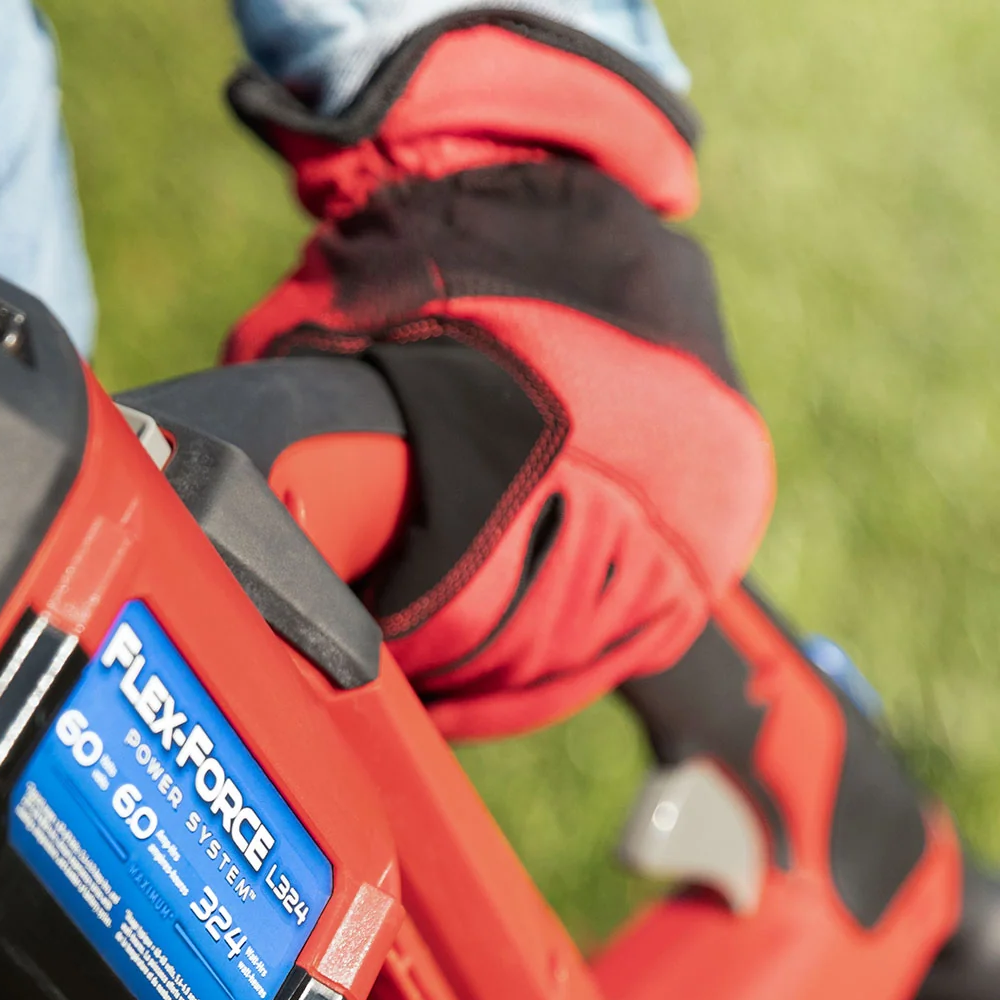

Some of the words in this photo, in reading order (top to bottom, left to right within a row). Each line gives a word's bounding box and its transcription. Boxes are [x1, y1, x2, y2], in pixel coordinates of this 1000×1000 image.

[55, 709, 103, 766] 60
[112, 783, 157, 838] 6.0
[189, 885, 247, 958] 324
[102, 623, 274, 871] FLEX-FORCE
[265, 864, 308, 925] L324
[124, 728, 182, 808] POWER
[245, 945, 267, 976] Watt-Hrs
